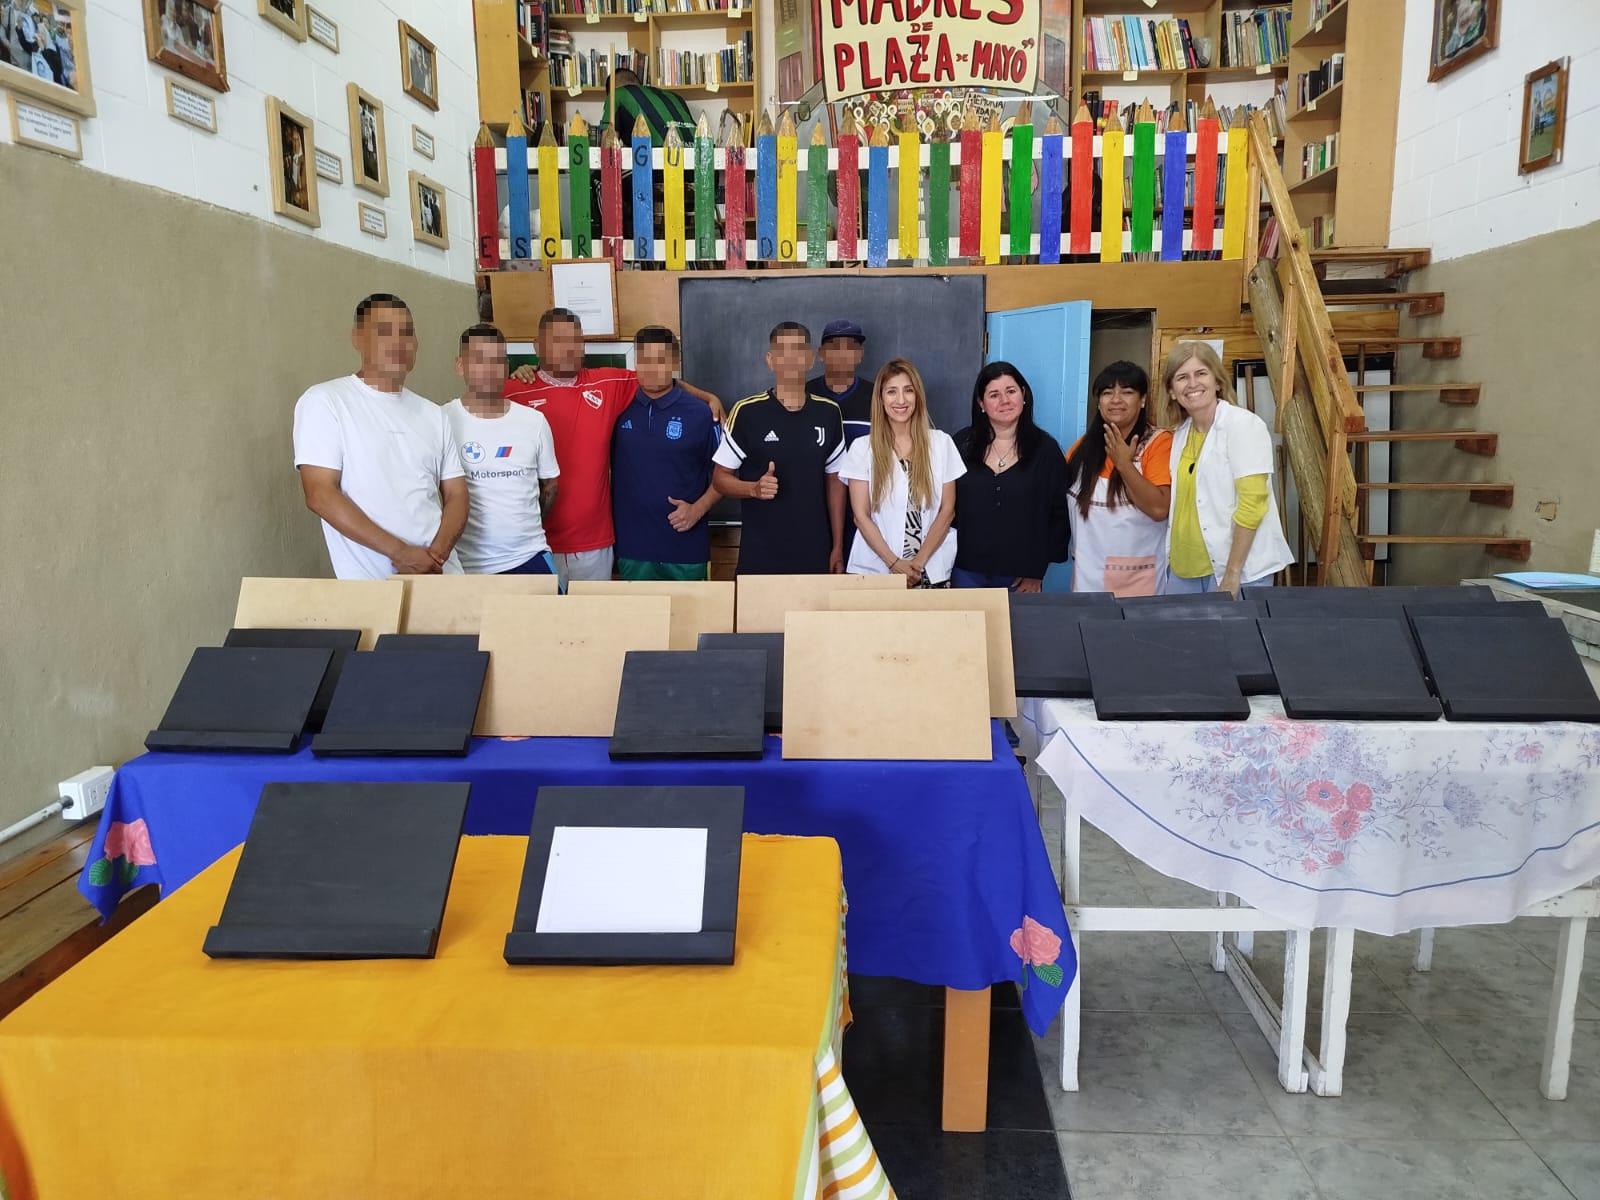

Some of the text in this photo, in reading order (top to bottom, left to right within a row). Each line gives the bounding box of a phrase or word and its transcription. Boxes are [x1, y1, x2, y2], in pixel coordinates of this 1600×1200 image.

[910, 21, 934, 33] DE
[833, 33, 955, 92] PLAZA
[955, 53, 969, 62] DE
[471, 469, 525, 480] Motorsport
